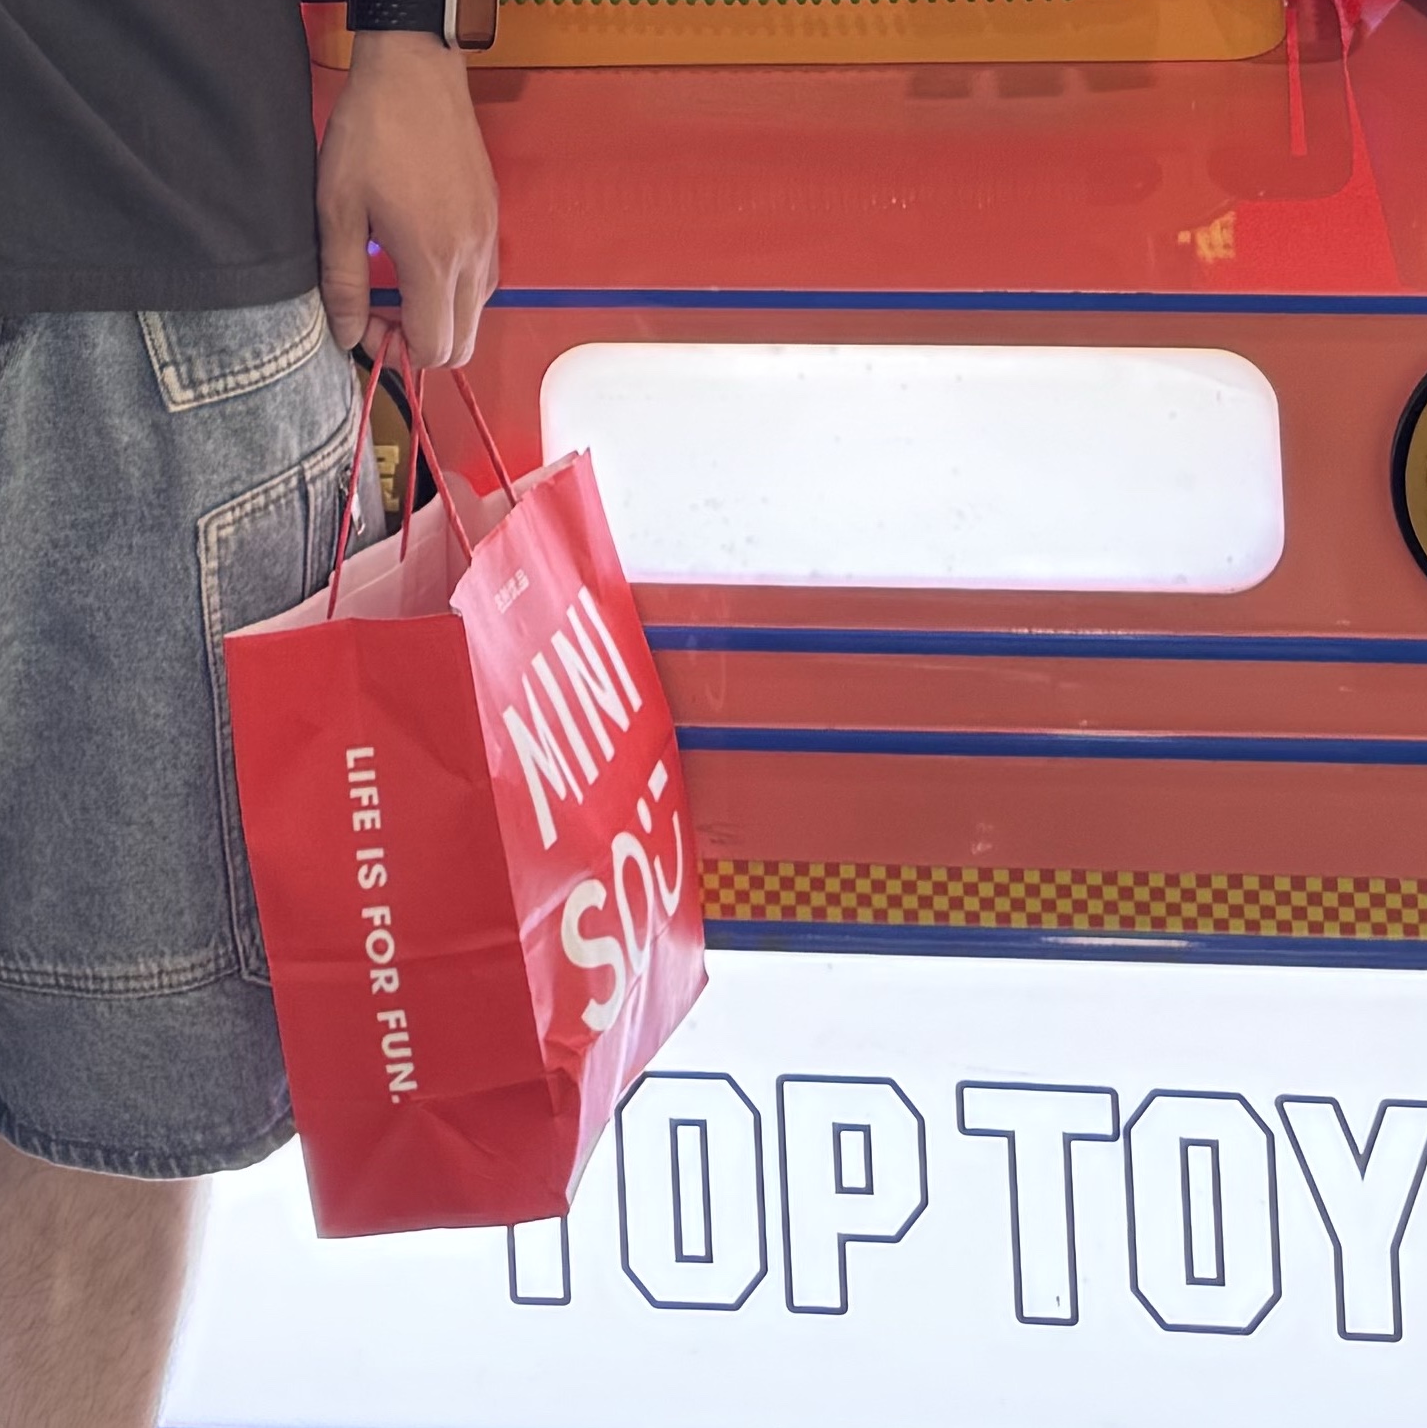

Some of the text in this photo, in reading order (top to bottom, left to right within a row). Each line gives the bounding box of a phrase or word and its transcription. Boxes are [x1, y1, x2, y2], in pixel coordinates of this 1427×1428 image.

[502, 586, 642, 850] MINI
[344, 747, 417, 1105] LIFE IS FOR FUN.
